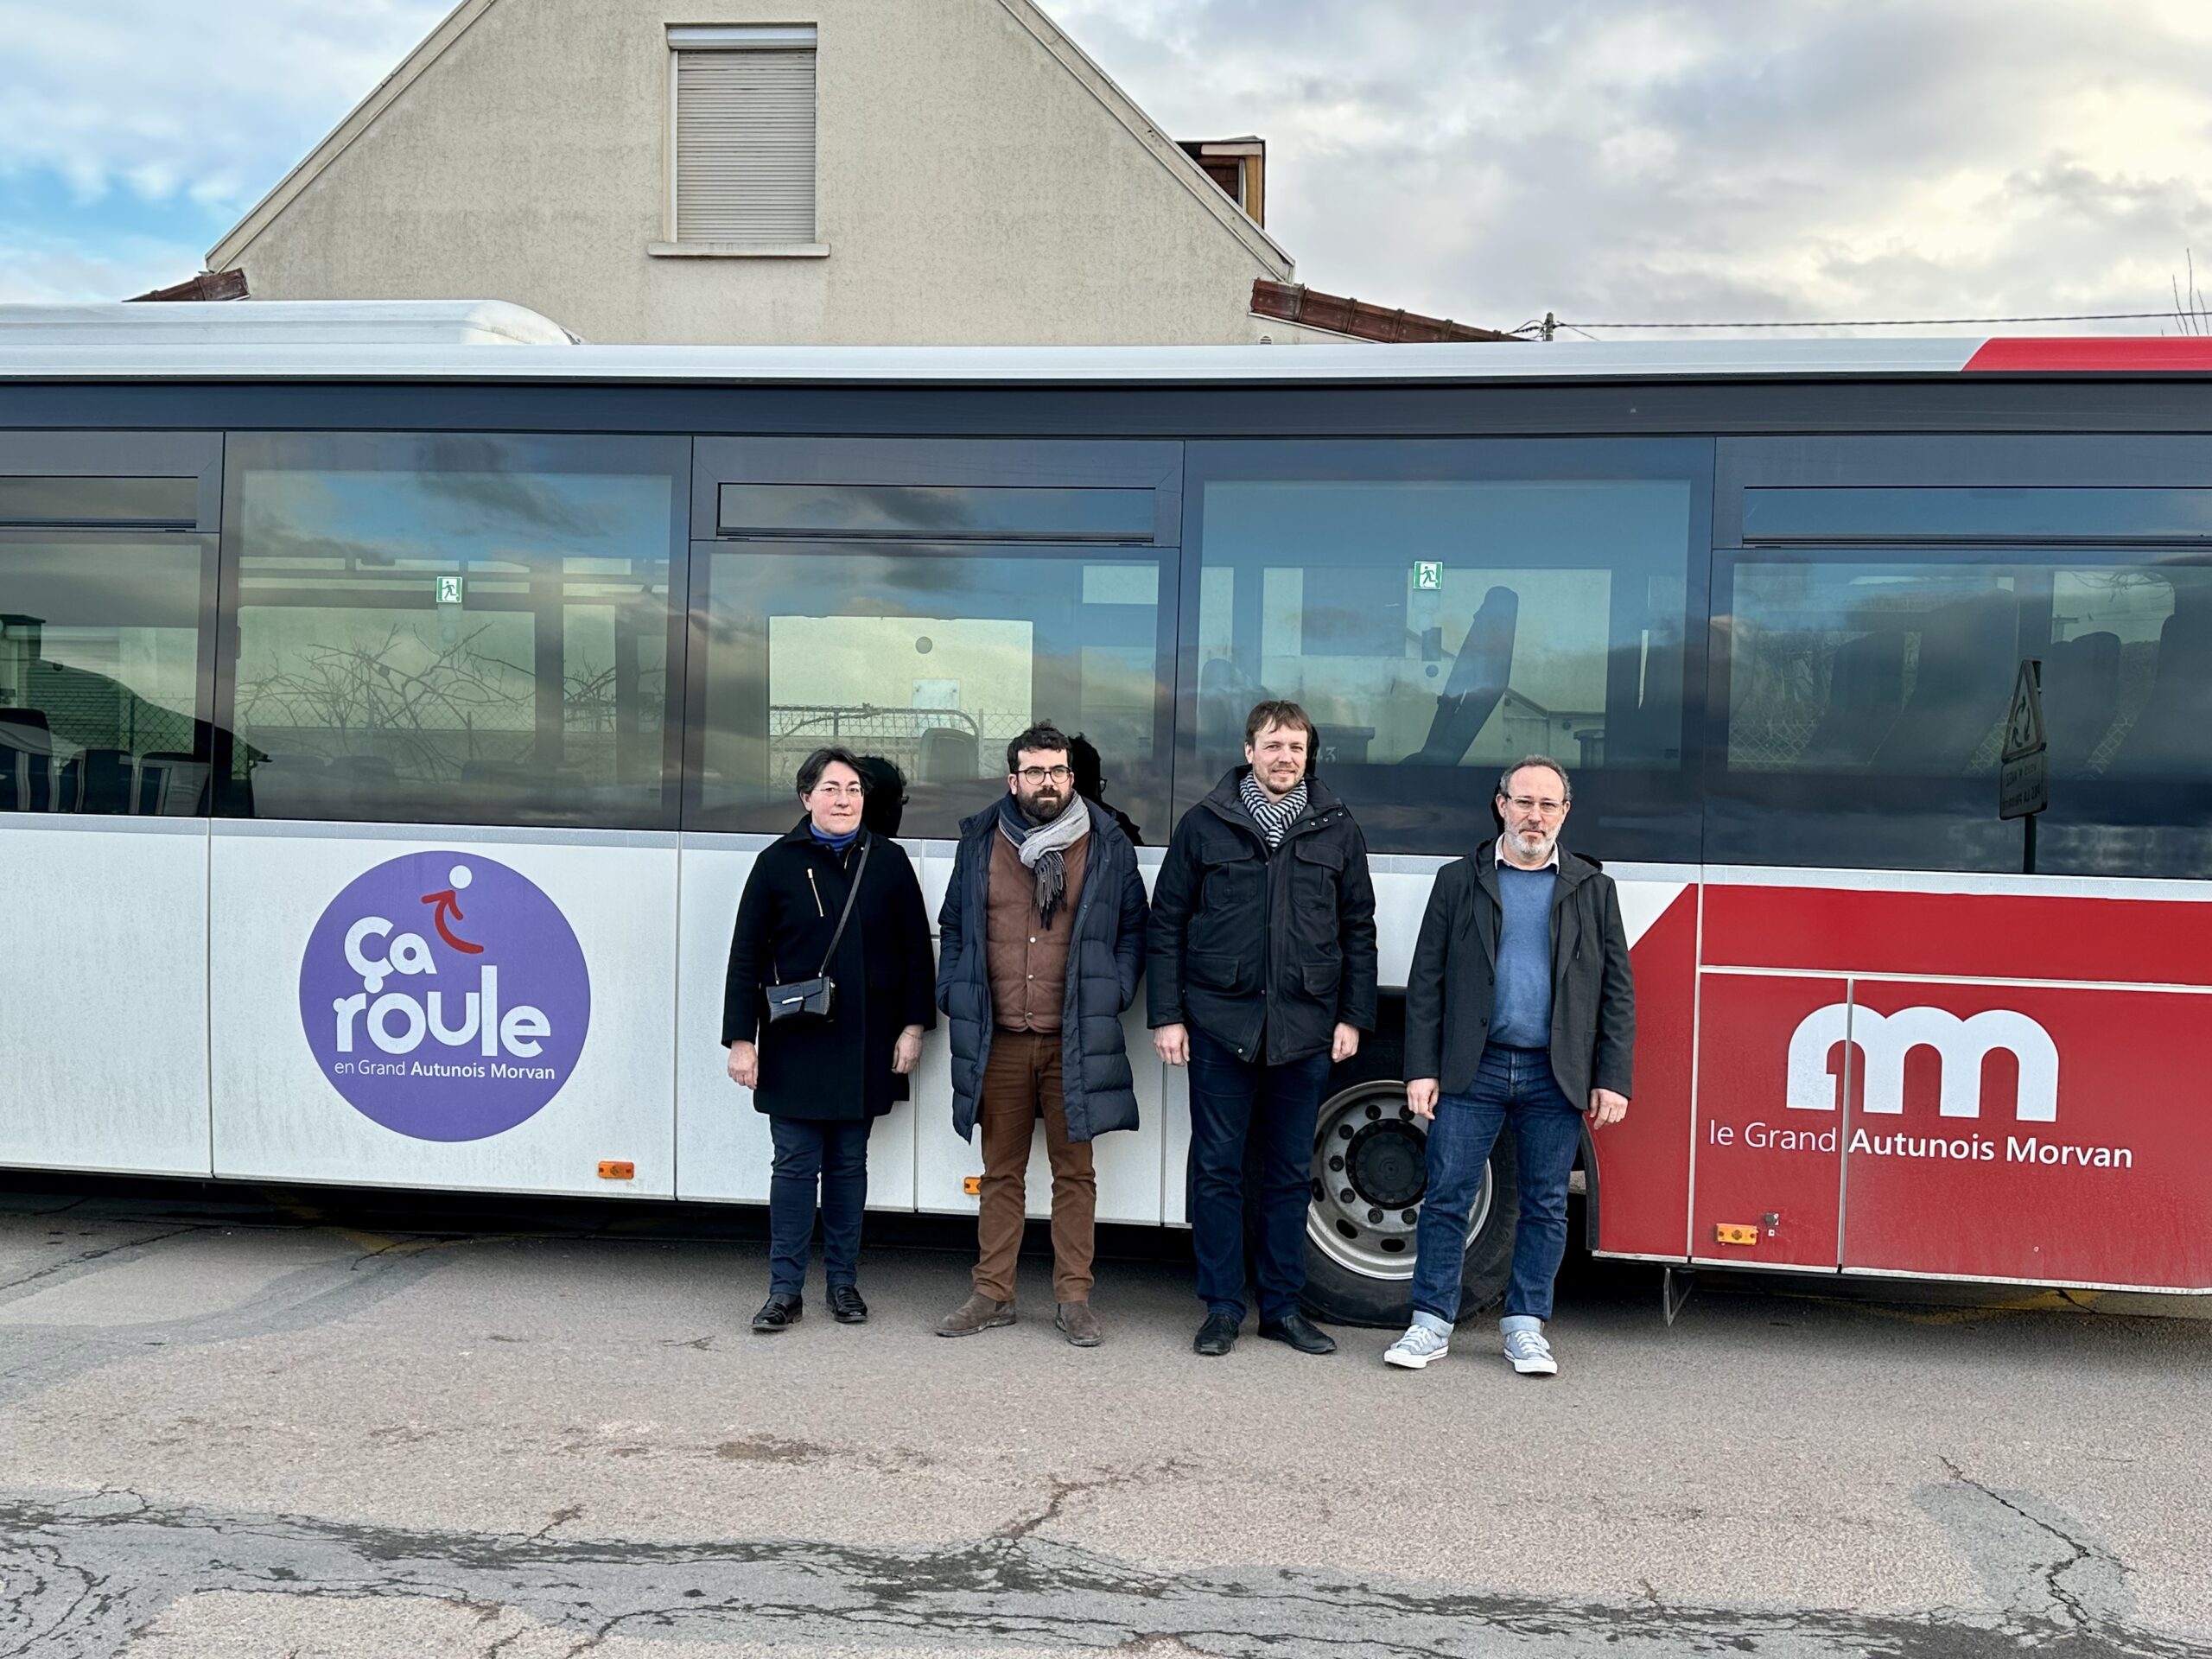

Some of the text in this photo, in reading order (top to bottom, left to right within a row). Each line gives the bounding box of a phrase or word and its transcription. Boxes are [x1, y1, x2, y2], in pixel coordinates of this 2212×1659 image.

[333, 964, 551, 1058] roule
[334, 1060, 555, 1080] en Grand Autunois Morvan
[1709, 1119, 2133, 1169] le Grand Autunois Morvan
